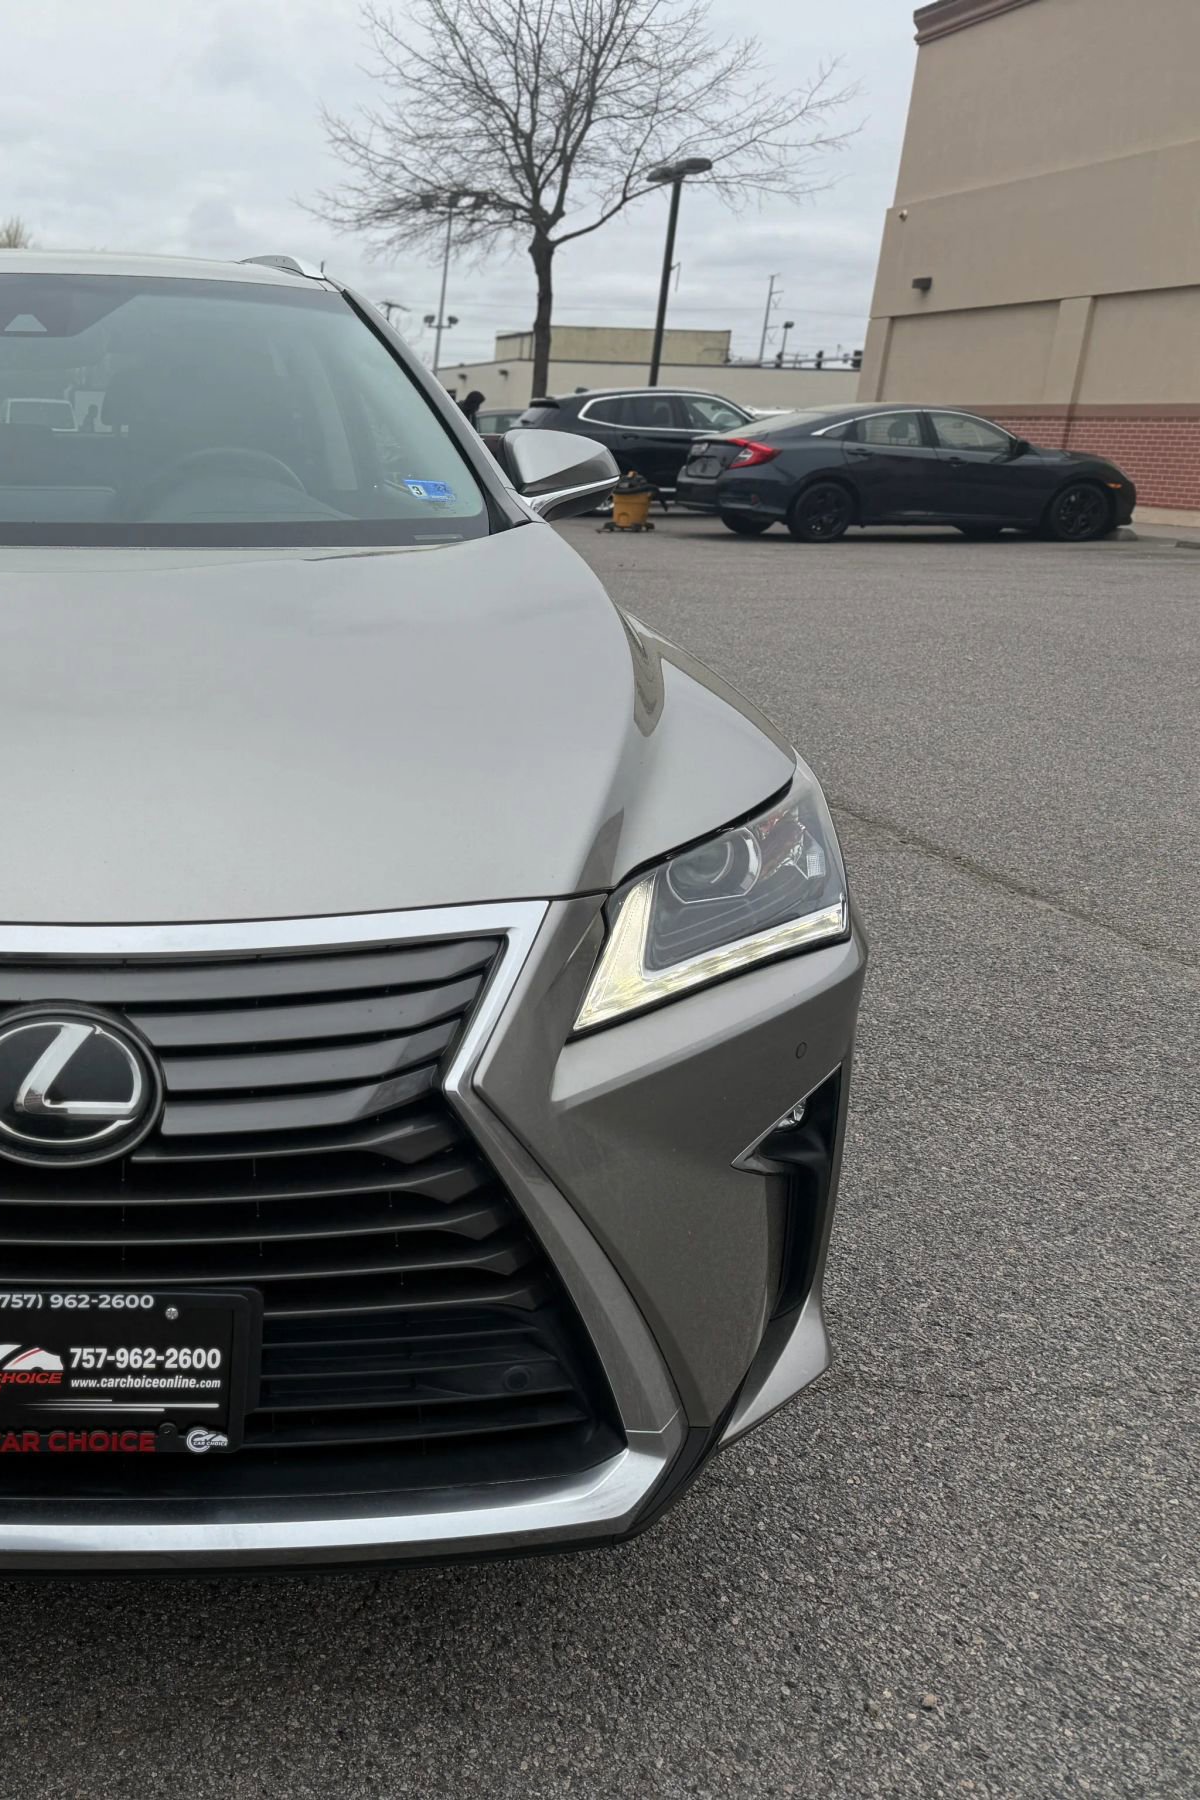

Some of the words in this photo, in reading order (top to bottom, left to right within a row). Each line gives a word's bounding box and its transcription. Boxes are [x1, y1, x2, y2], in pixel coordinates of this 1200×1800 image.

[49, 1294, 155, 1309] 962-2600
[69, 1347, 221, 1369] 757-962-2600
[70, 1375, 221, 1389] www.carchoiceonline.com
[48, 1431, 157, 1453] CHOICE
